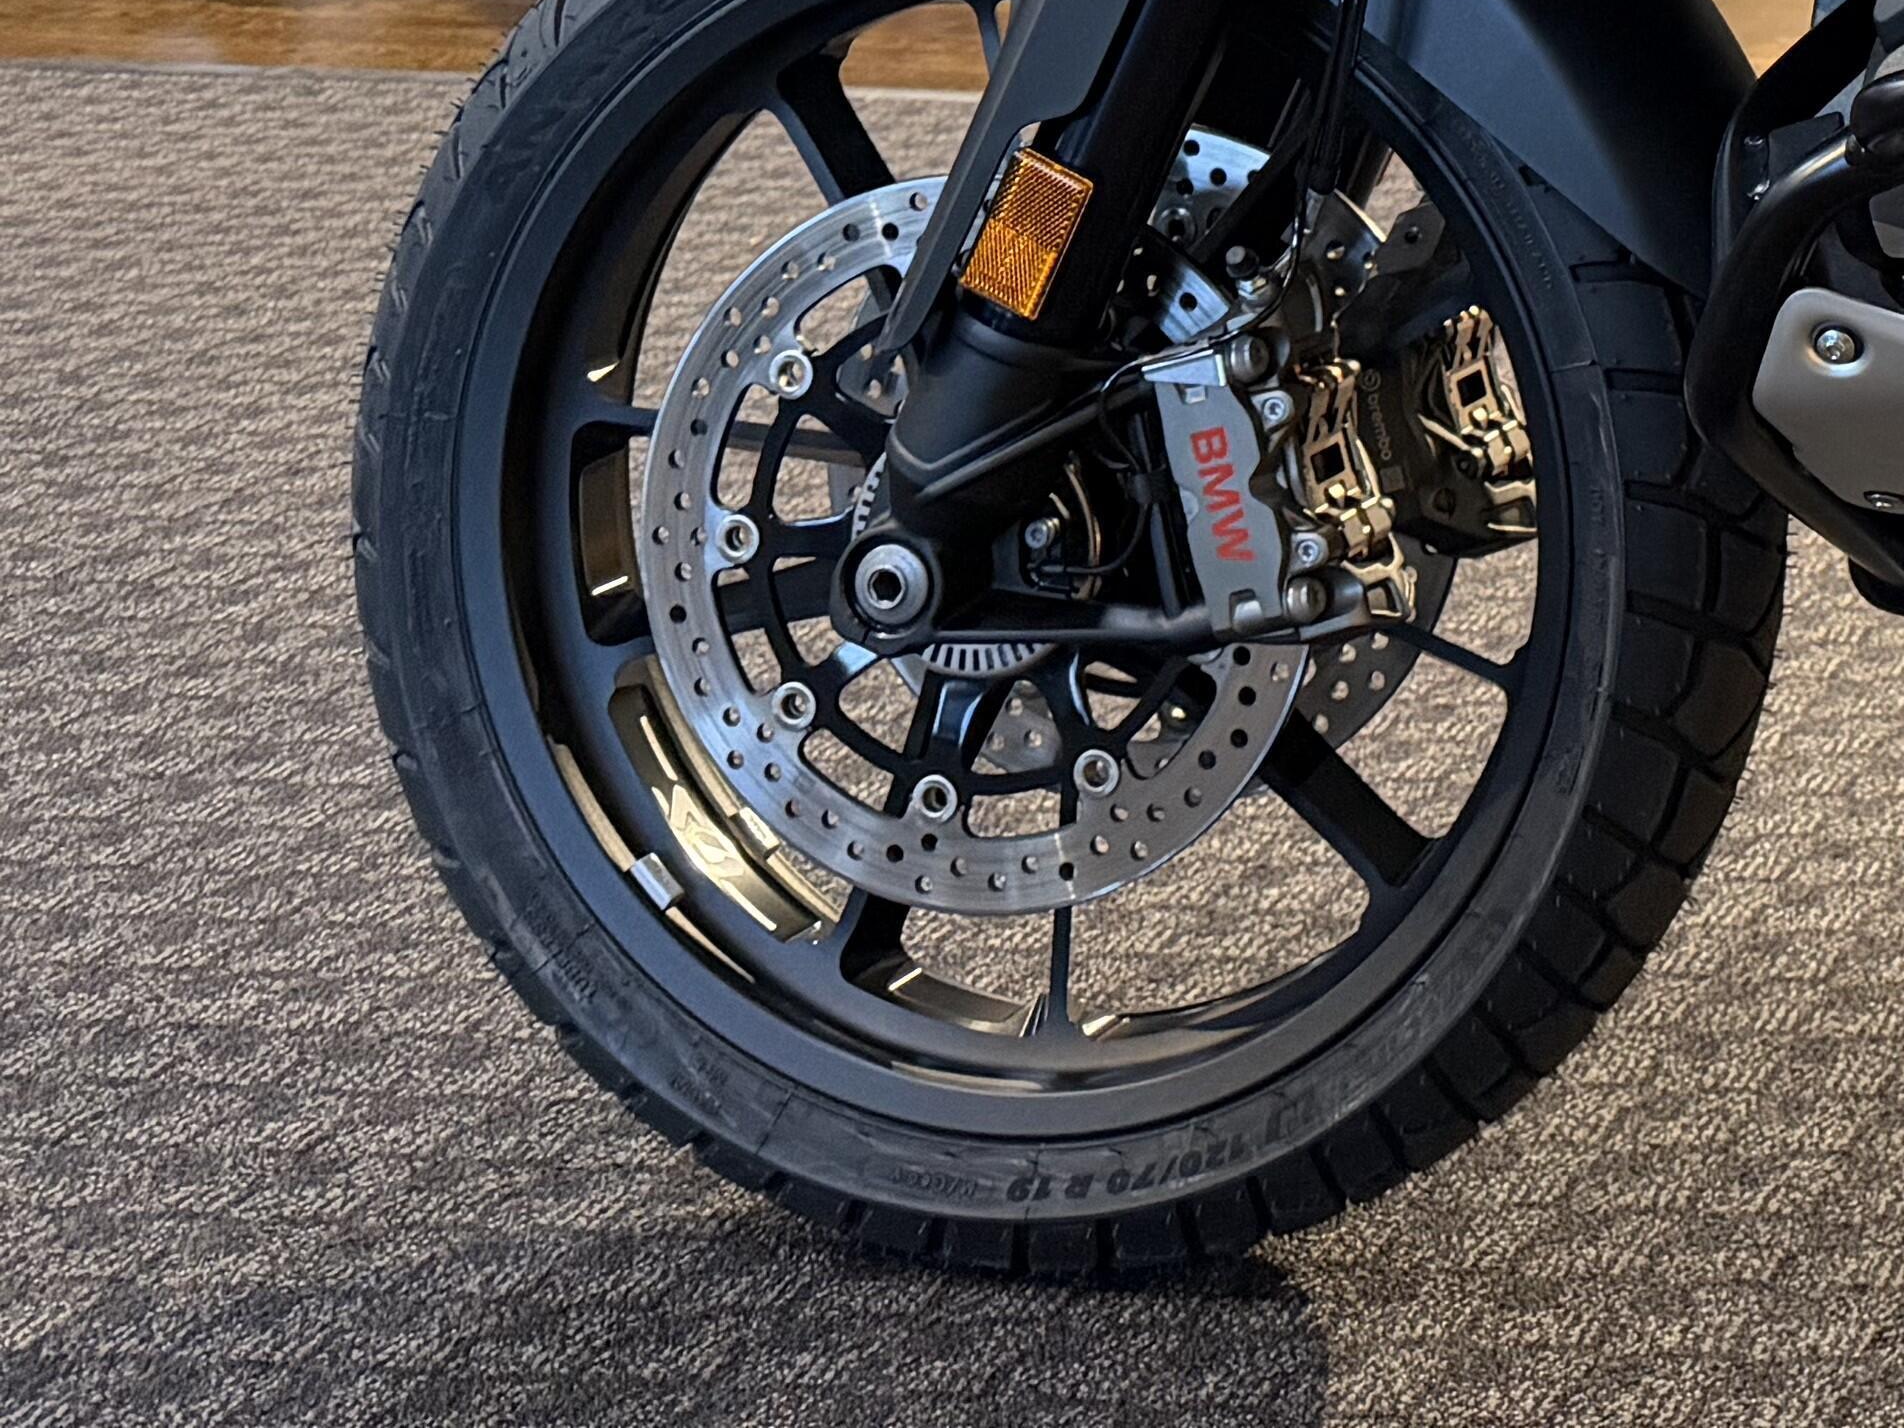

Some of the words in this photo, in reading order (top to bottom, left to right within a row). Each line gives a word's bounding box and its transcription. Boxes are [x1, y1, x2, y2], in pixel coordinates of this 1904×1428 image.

[1189, 425, 1257, 562] BMW
[1063, 1173, 1096, 1200] R
[1104, 1138, 1249, 1195] 120/70
[1005, 1176, 1052, 1202] 19
